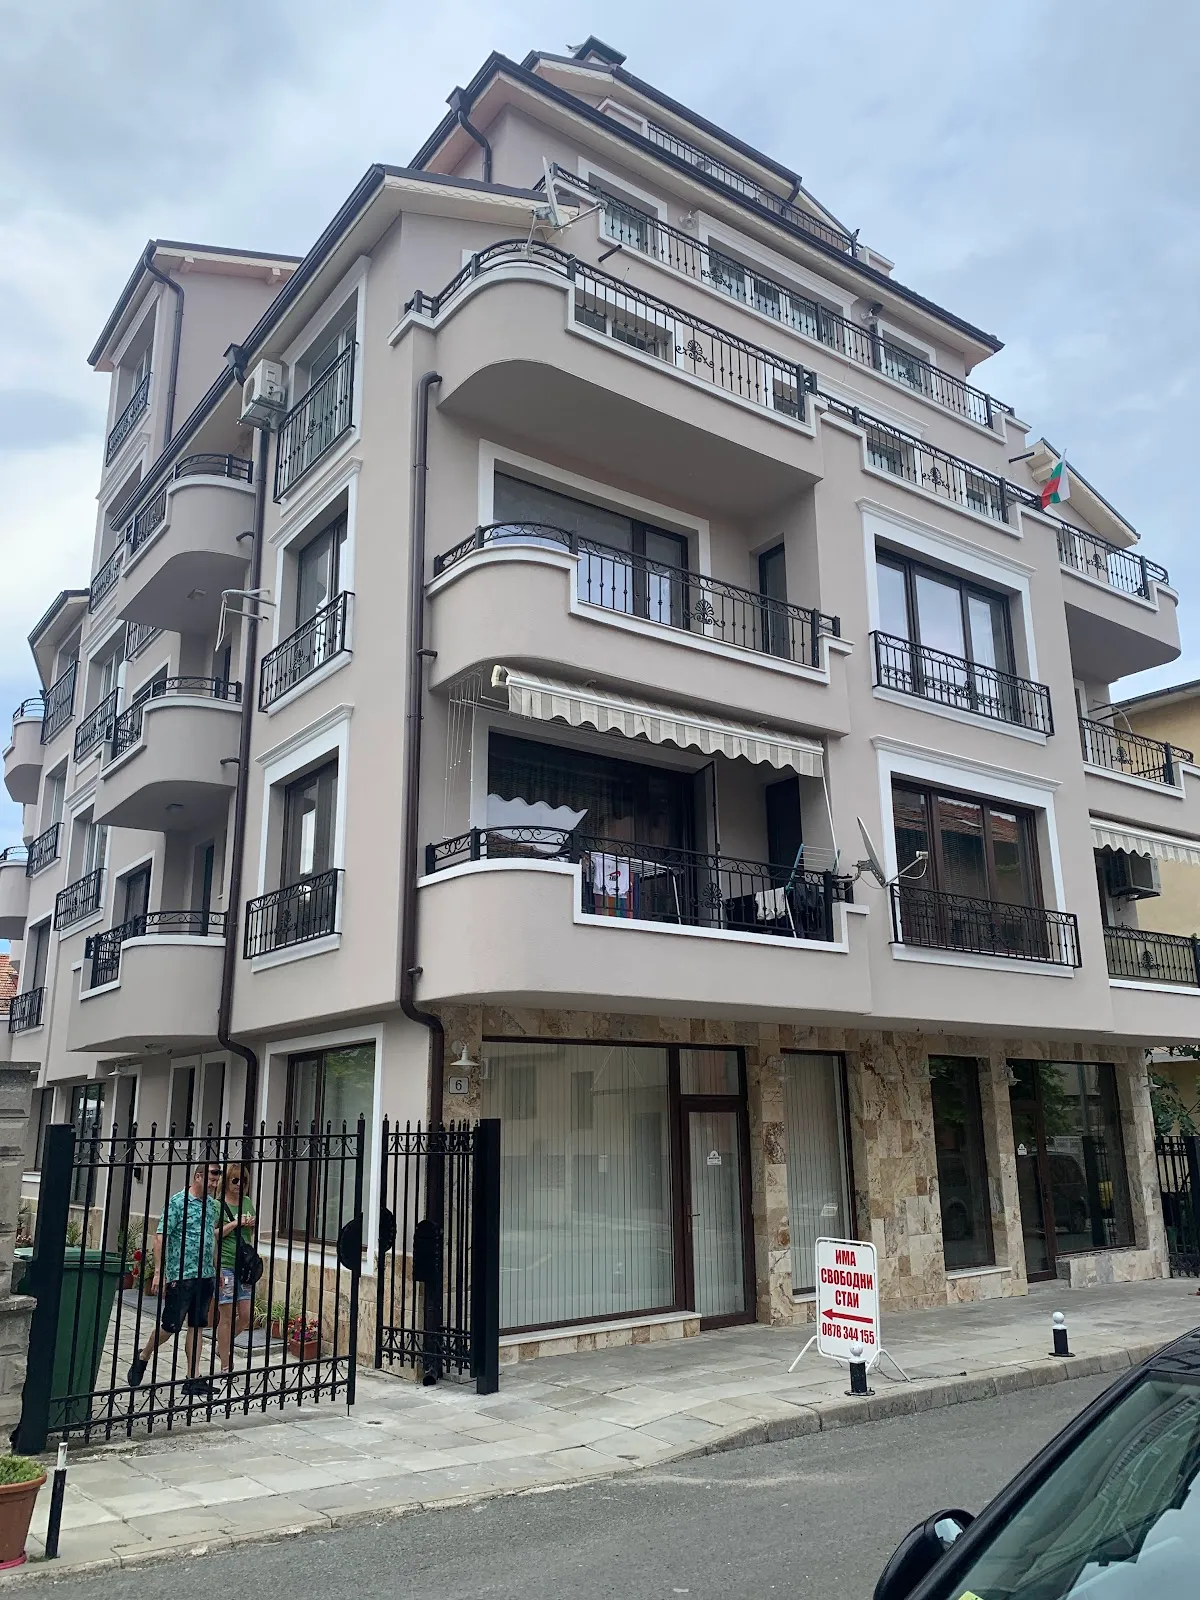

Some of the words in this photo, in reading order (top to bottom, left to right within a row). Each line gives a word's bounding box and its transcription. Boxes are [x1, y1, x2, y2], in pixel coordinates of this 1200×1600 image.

[455, 1080, 462, 1091] 6
[835, 1249, 857, 1267] ИМА
[820, 1268, 873, 1290] СВОБОДНИ
[835, 1289, 860, 1309] СТАИ
[822, 1322, 842, 1339] 0878
[843, 1326, 859, 1342] 344
[860, 1329, 875, 1345] 155
